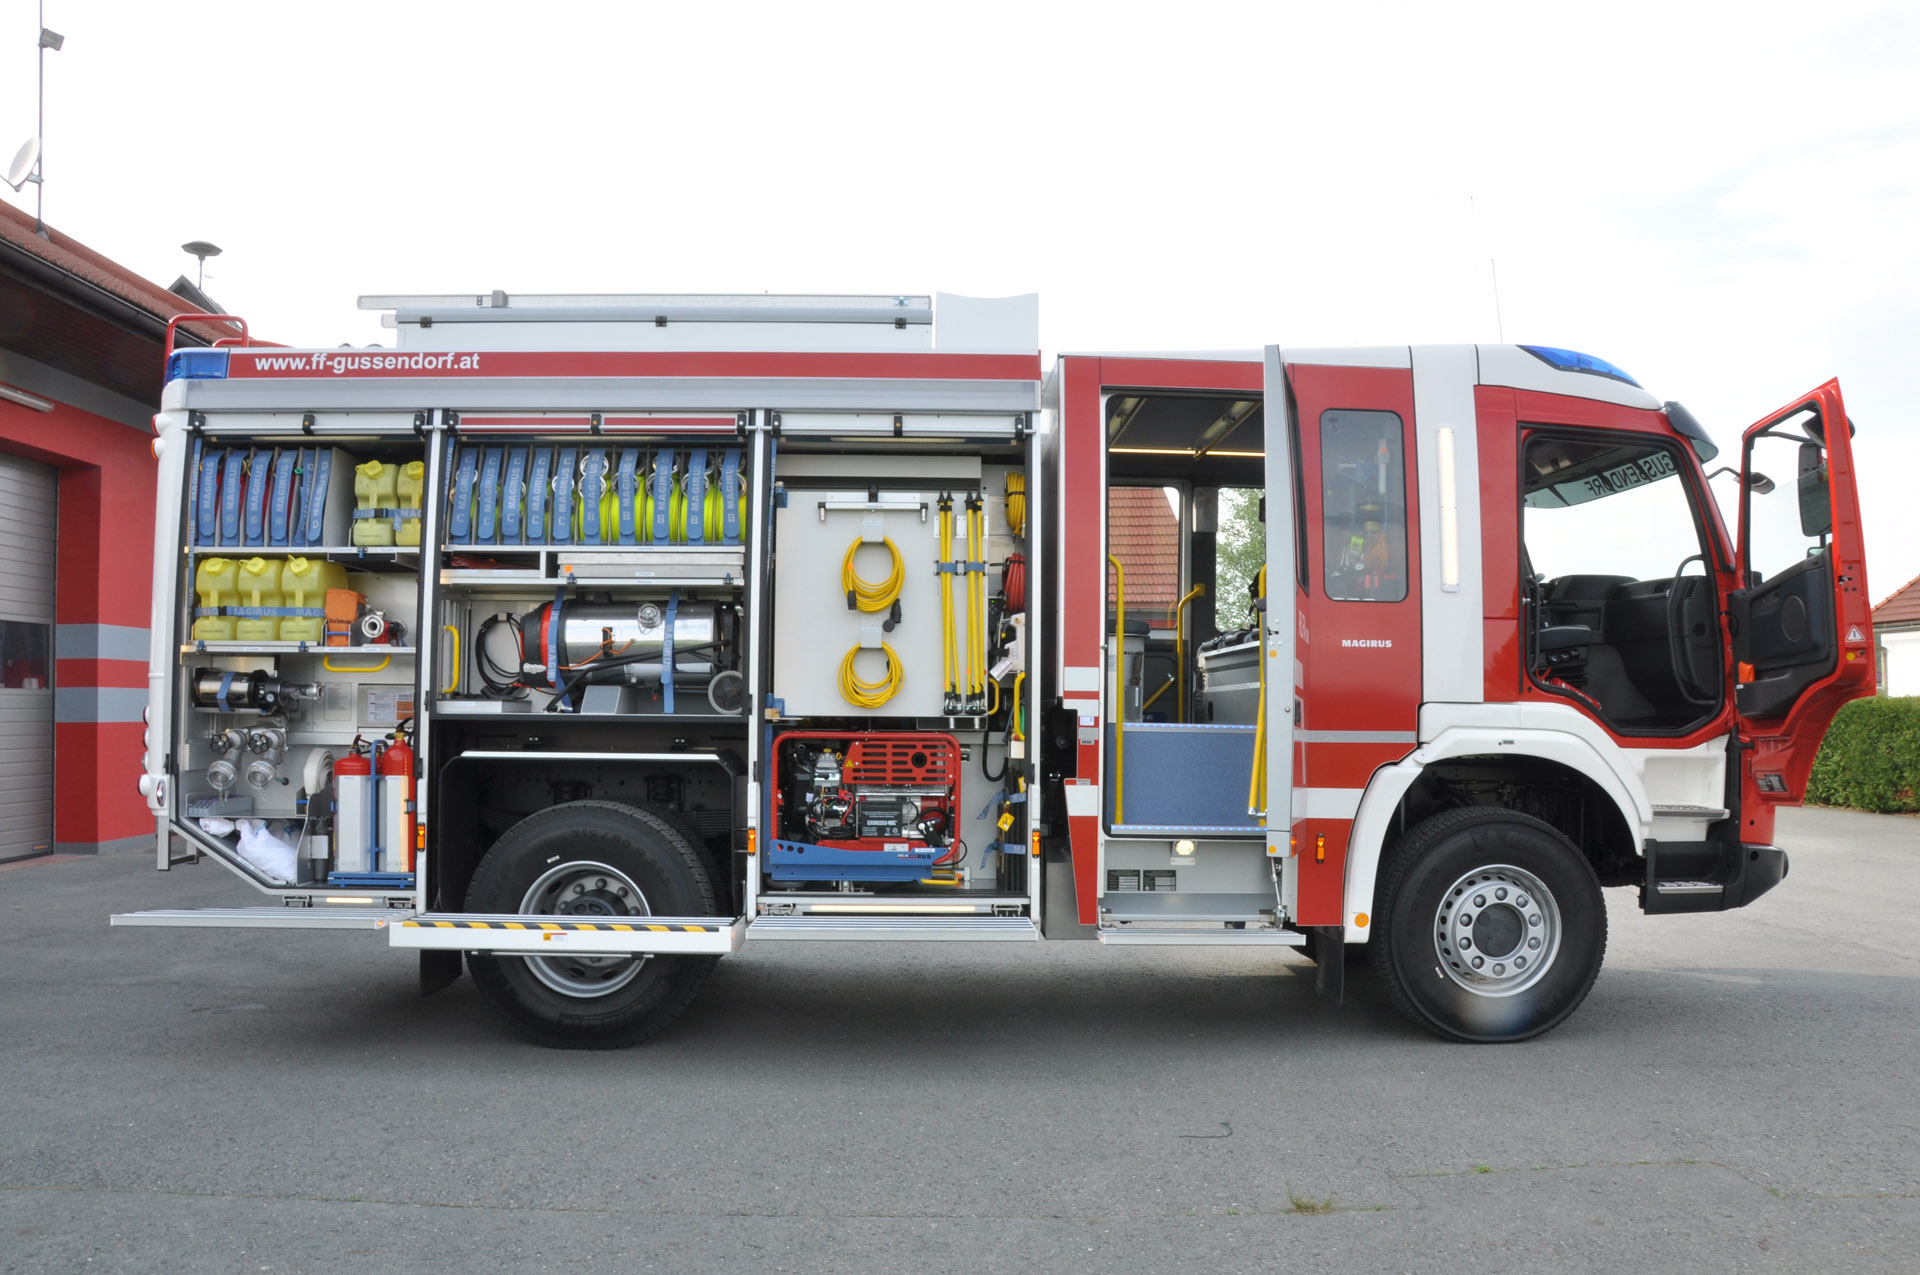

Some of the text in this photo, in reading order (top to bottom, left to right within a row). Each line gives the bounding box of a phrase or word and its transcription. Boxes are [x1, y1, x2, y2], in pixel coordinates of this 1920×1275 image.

[255, 353, 480, 374] www.ff-gussendorf.at
[203, 461, 214, 509] MAGIRUS
[226, 462, 238, 511] MAGIRUS
[251, 464, 264, 511] MAGIRUS
[276, 464, 288, 512] MAGIRUS
[313, 473, 326, 517] MAGIRUS
[458, 466, 471, 510] MAGIRUS
[484, 468, 495, 512] MAGIRUS
[508, 468, 520, 509] MAGIRUS
[532, 468, 545, 512] MAGIRUS
[558, 468, 570, 512] MAGIRUS
[588, 464, 599, 508] MAGIRUS
[623, 464, 632, 507] MAGIRUS
[658, 465, 668, 511] MAGIRUS
[692, 465, 701, 512] MAGIRUS
[727, 464, 735, 509] MAGIRUS
[663, 624, 673, 672] MAGIRUS
[1342, 639, 1392, 648] MAGIRUS
